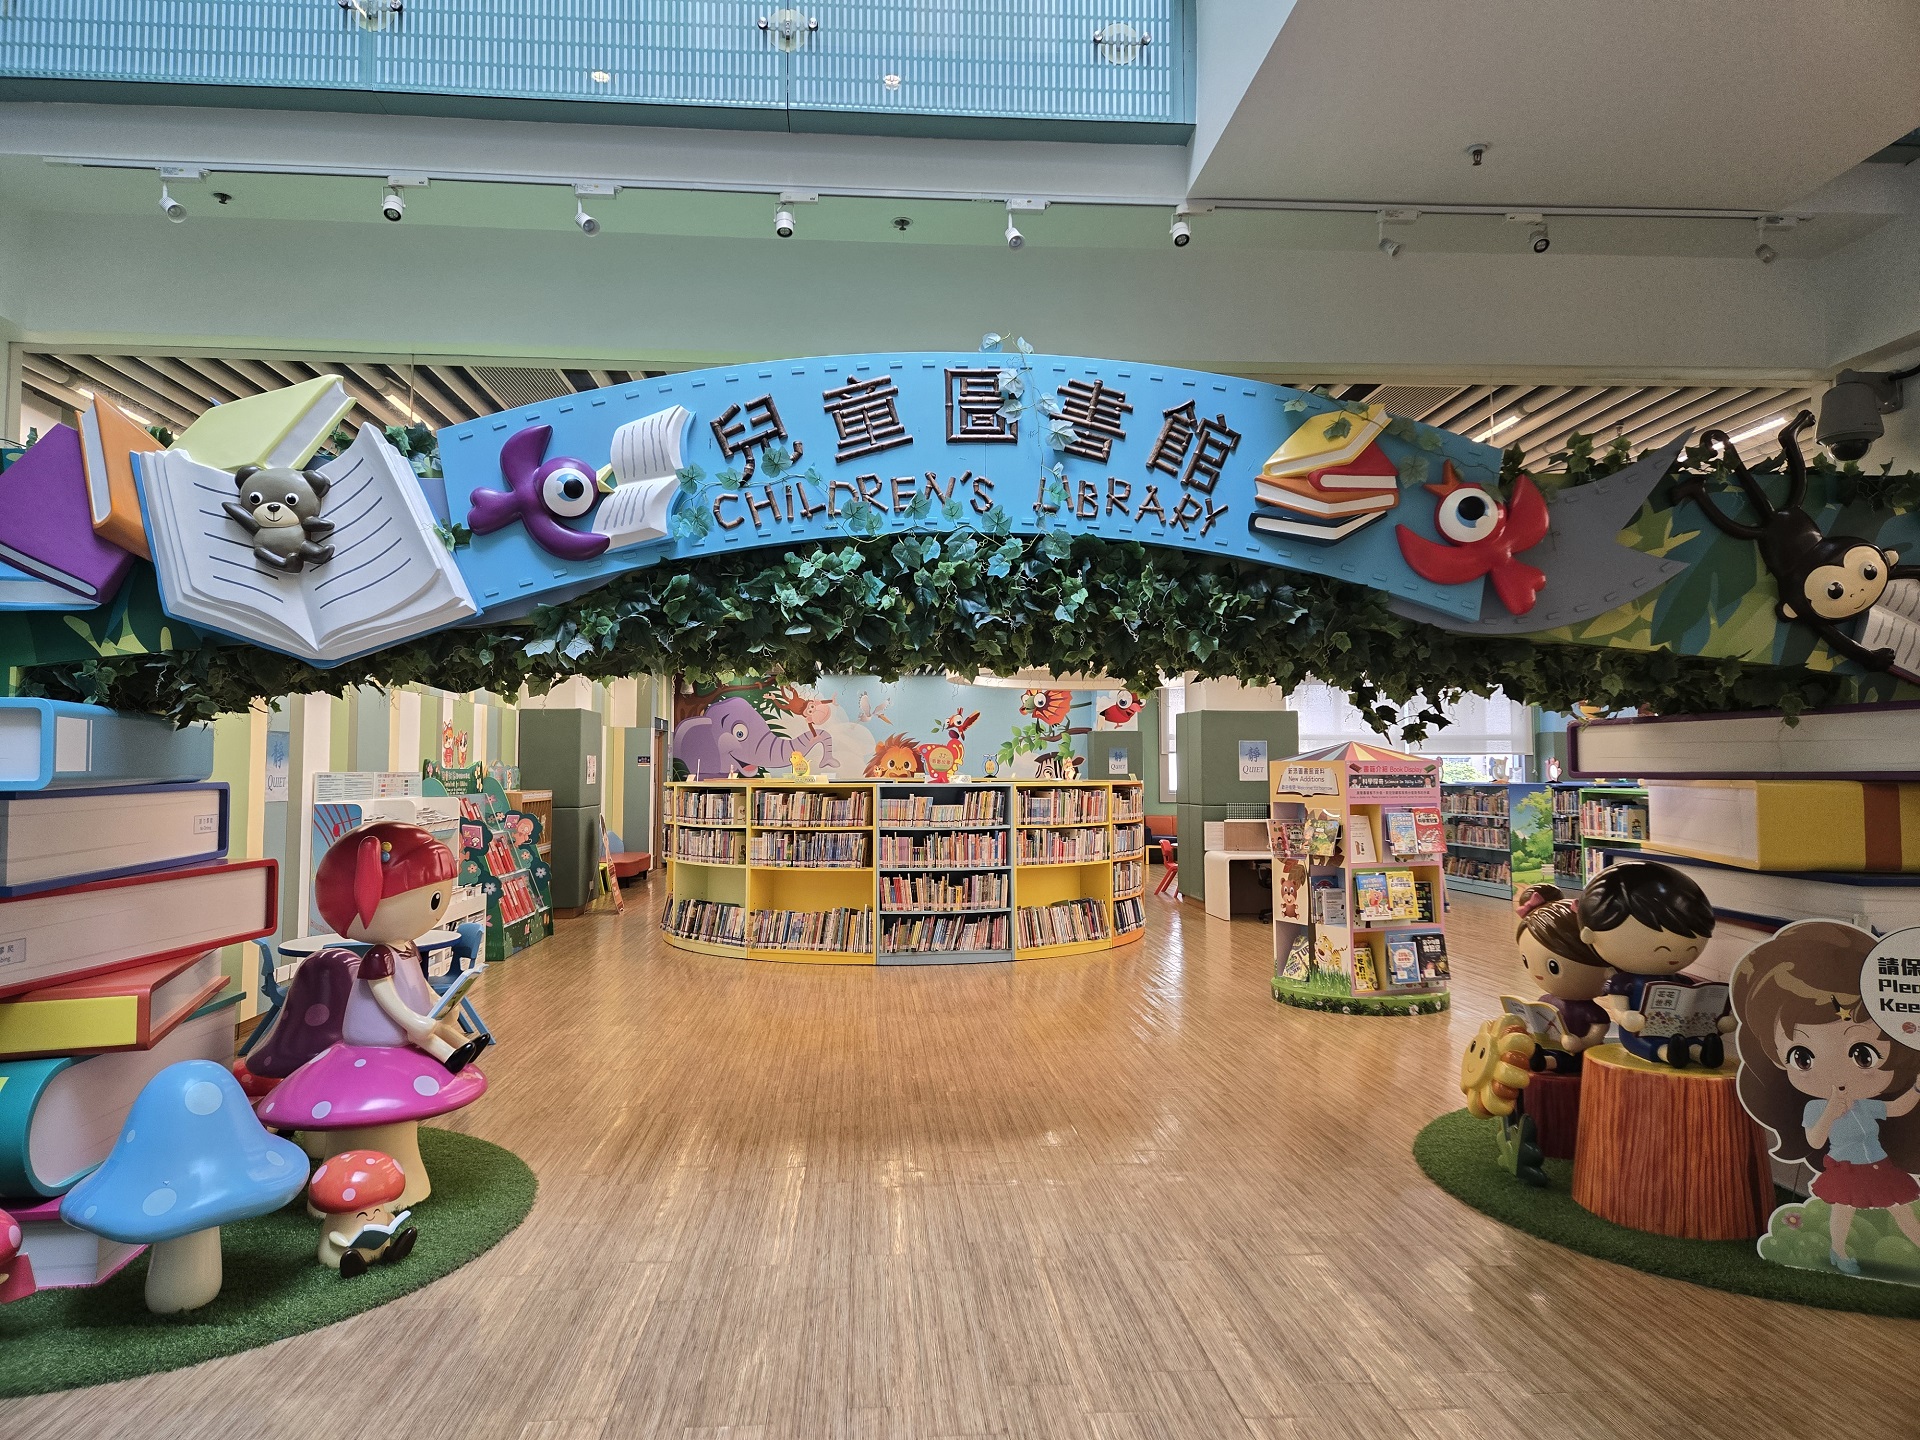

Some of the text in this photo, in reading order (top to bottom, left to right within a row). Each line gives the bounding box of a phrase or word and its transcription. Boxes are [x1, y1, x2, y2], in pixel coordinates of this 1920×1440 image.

[710, 368, 1242, 494] 兒童圖書館
[1033, 475, 1229, 536] LIBRARY
[1245, 746, 1261, 762] 靜
[1242, 764, 1265, 774] QUIET
[267, 774, 287, 791] QUIET
[1877, 957, 1920, 976] 請保
[1879, 998, 1920, 1013] Kee
